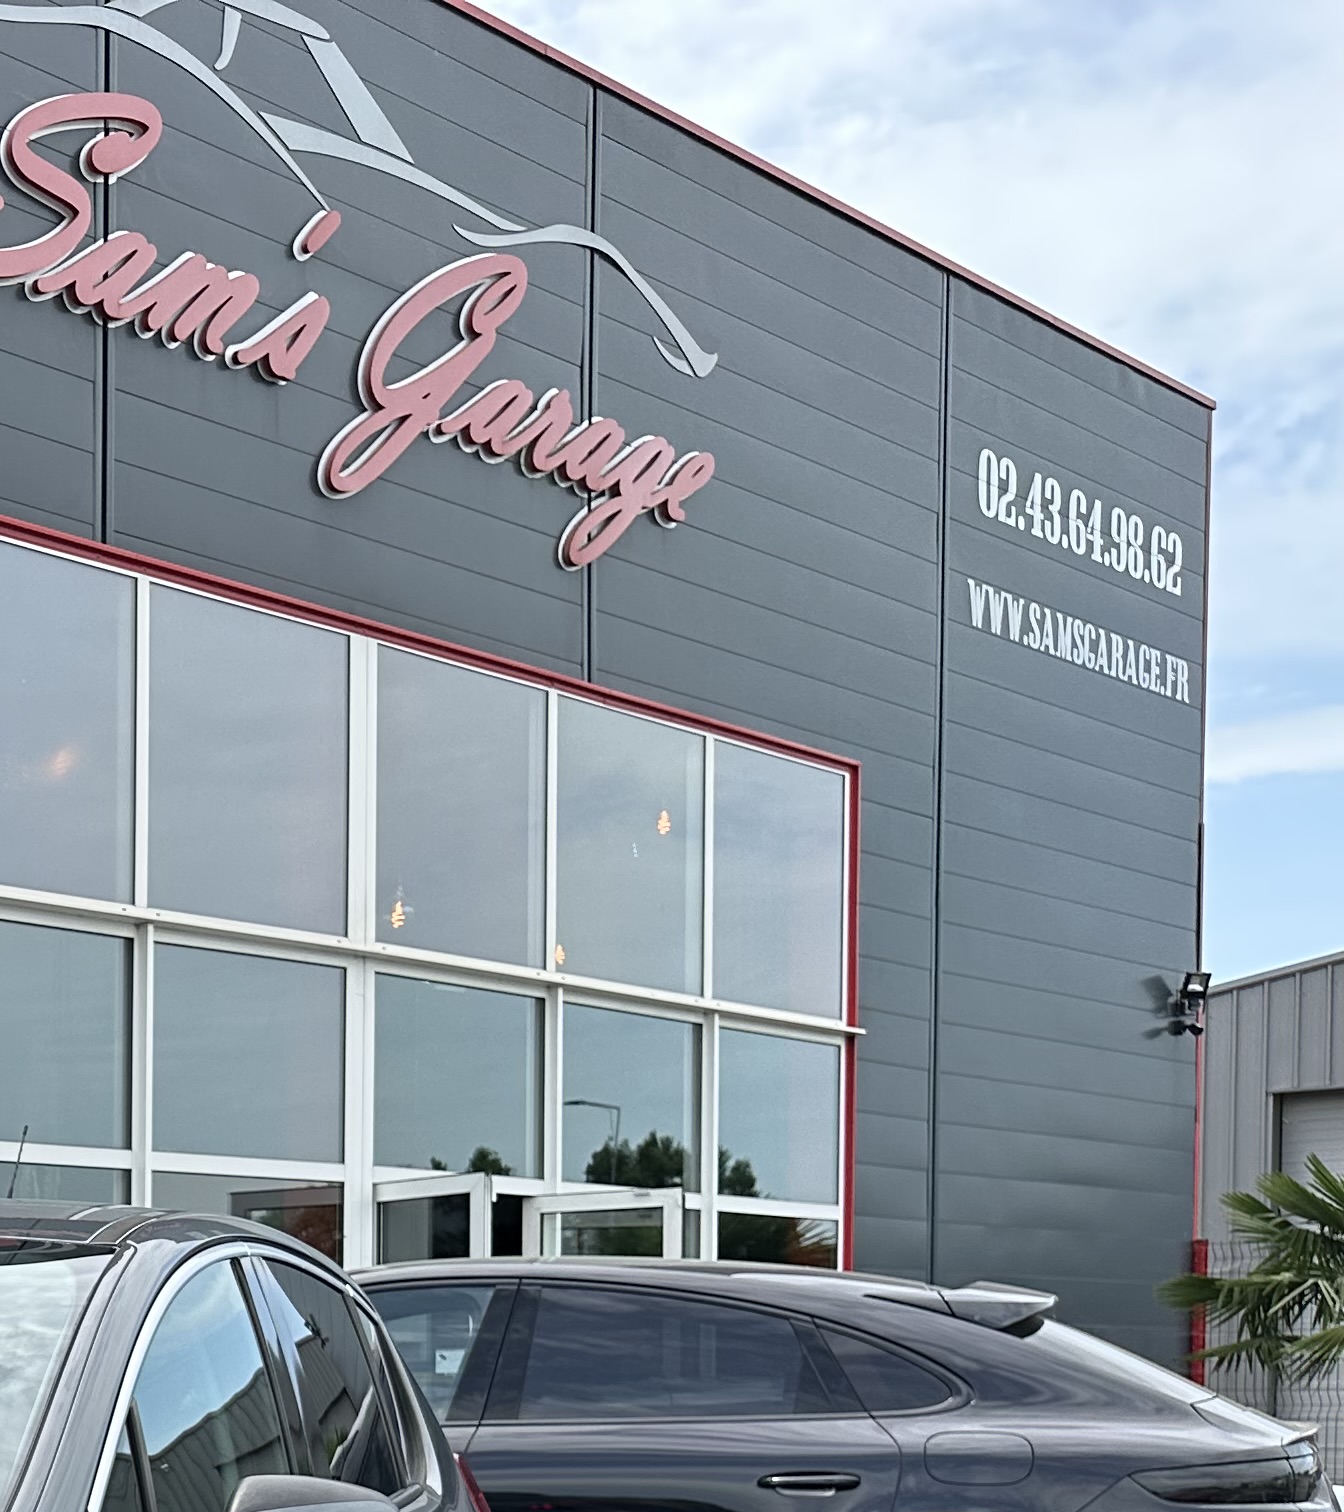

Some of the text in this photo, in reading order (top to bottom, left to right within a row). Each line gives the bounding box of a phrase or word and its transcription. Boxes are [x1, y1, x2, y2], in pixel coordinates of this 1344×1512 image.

[316, 251, 716, 571] Garage
[977, 448, 1184, 597] 02.43.64.98.62
[967, 577, 1191, 704] WWW.SAMSGARAGE.FR
